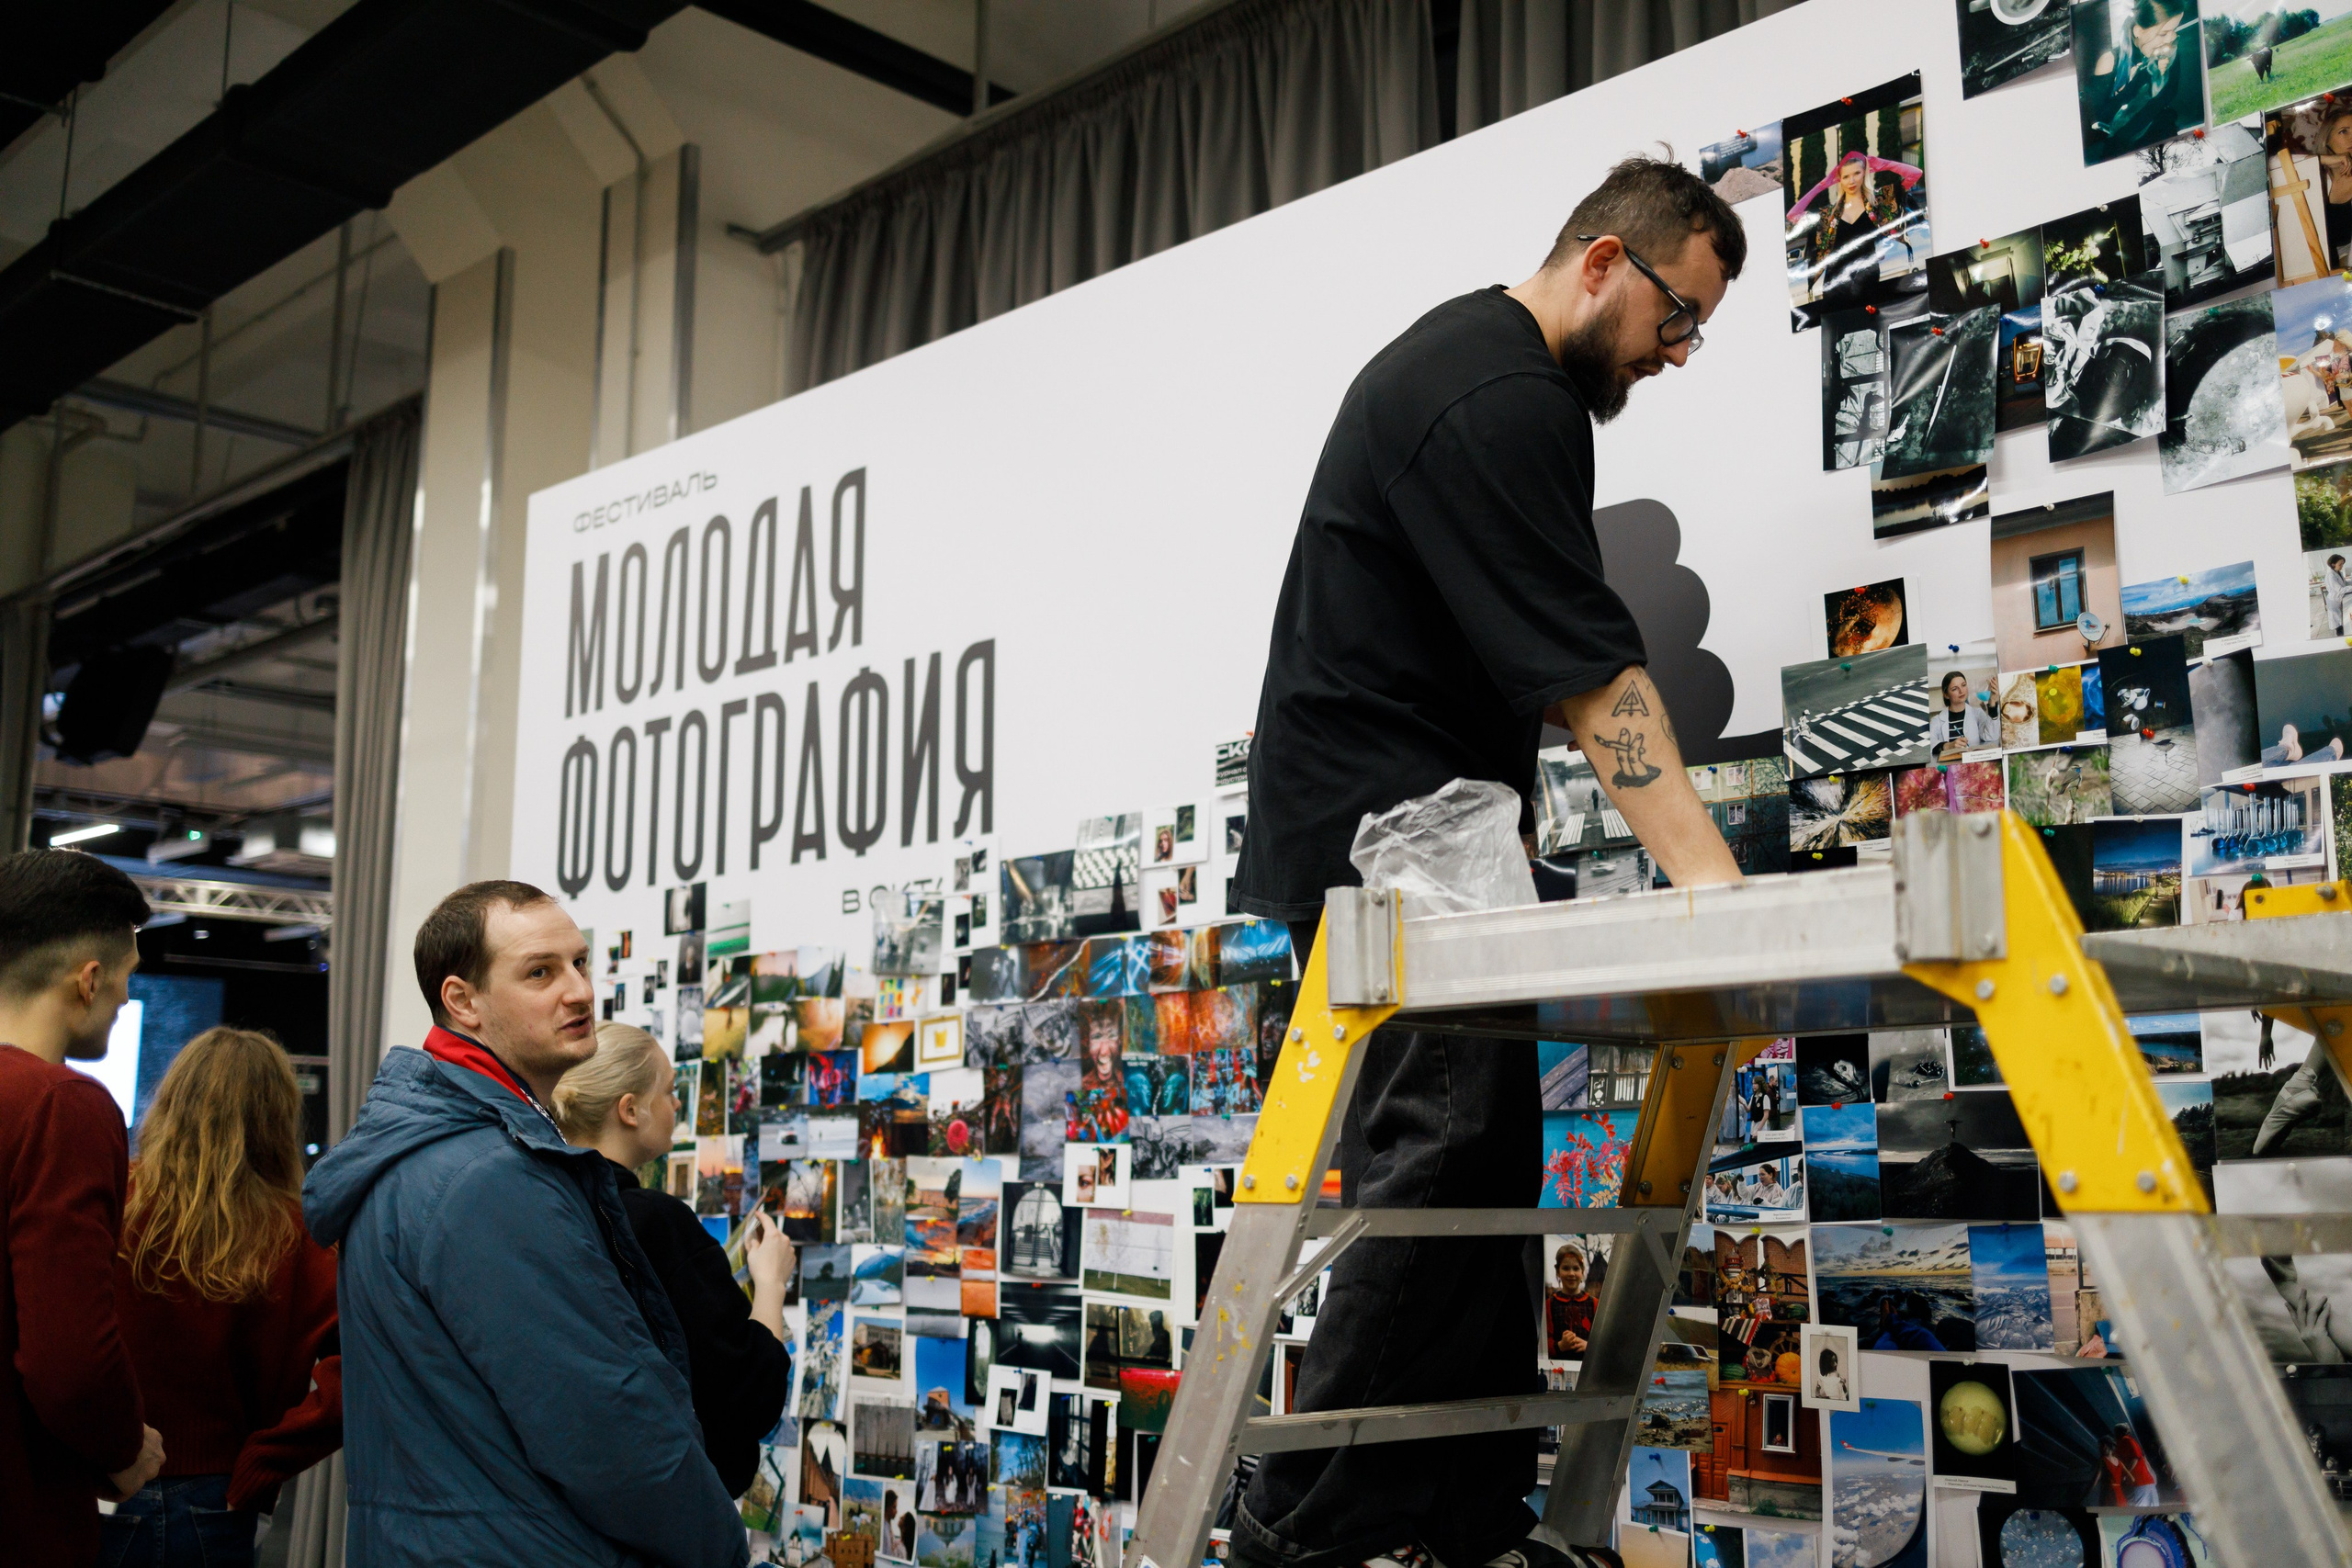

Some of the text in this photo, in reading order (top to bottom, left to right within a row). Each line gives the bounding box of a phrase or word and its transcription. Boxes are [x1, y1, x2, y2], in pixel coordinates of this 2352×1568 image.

[573, 470, 718, 535] ФЕСТИВАЛЬ
[564, 466, 866, 719] МОЛОДАЯ
[557, 637, 996, 900] ФОТОГРАФИЯ
[842, 889, 861, 914] В
